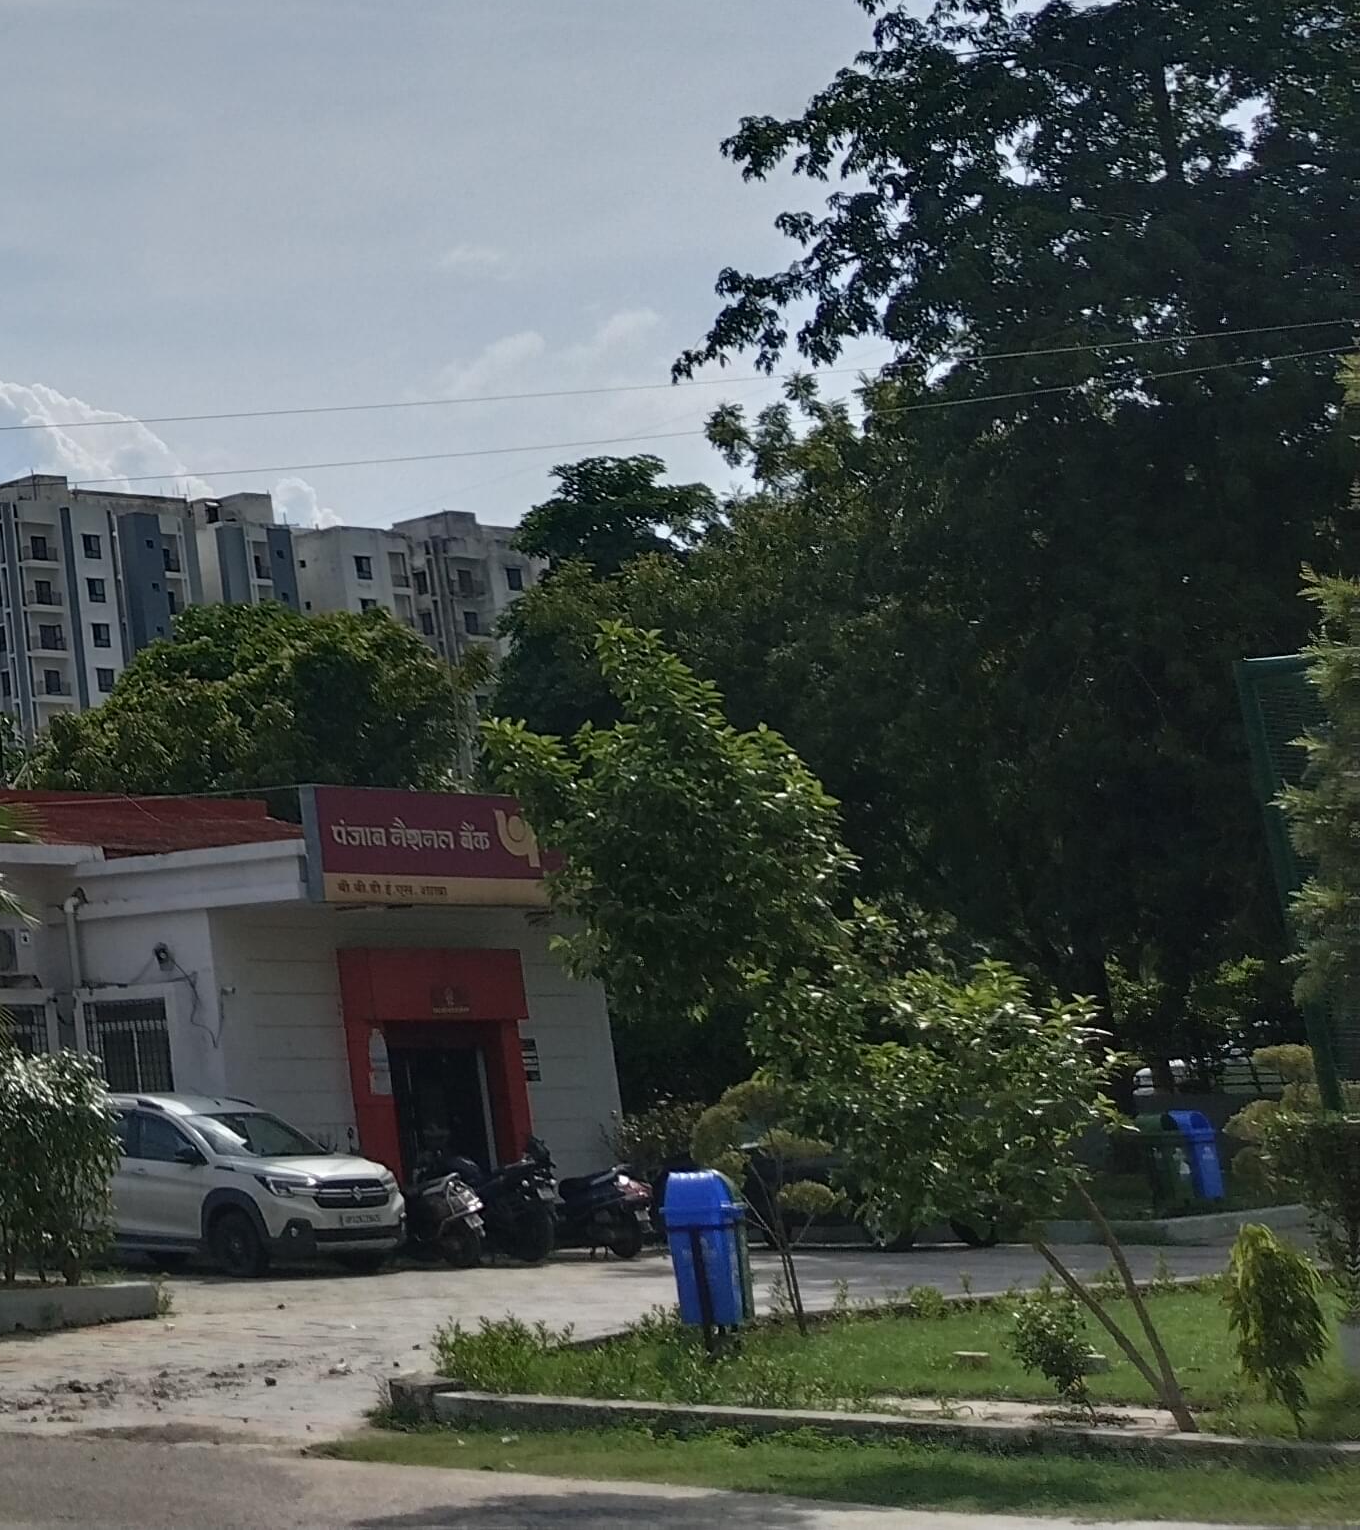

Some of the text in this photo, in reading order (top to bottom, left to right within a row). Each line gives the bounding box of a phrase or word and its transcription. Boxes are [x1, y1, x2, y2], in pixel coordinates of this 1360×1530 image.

[331, 817, 490, 851] पंजाब नैशनल बैंक
